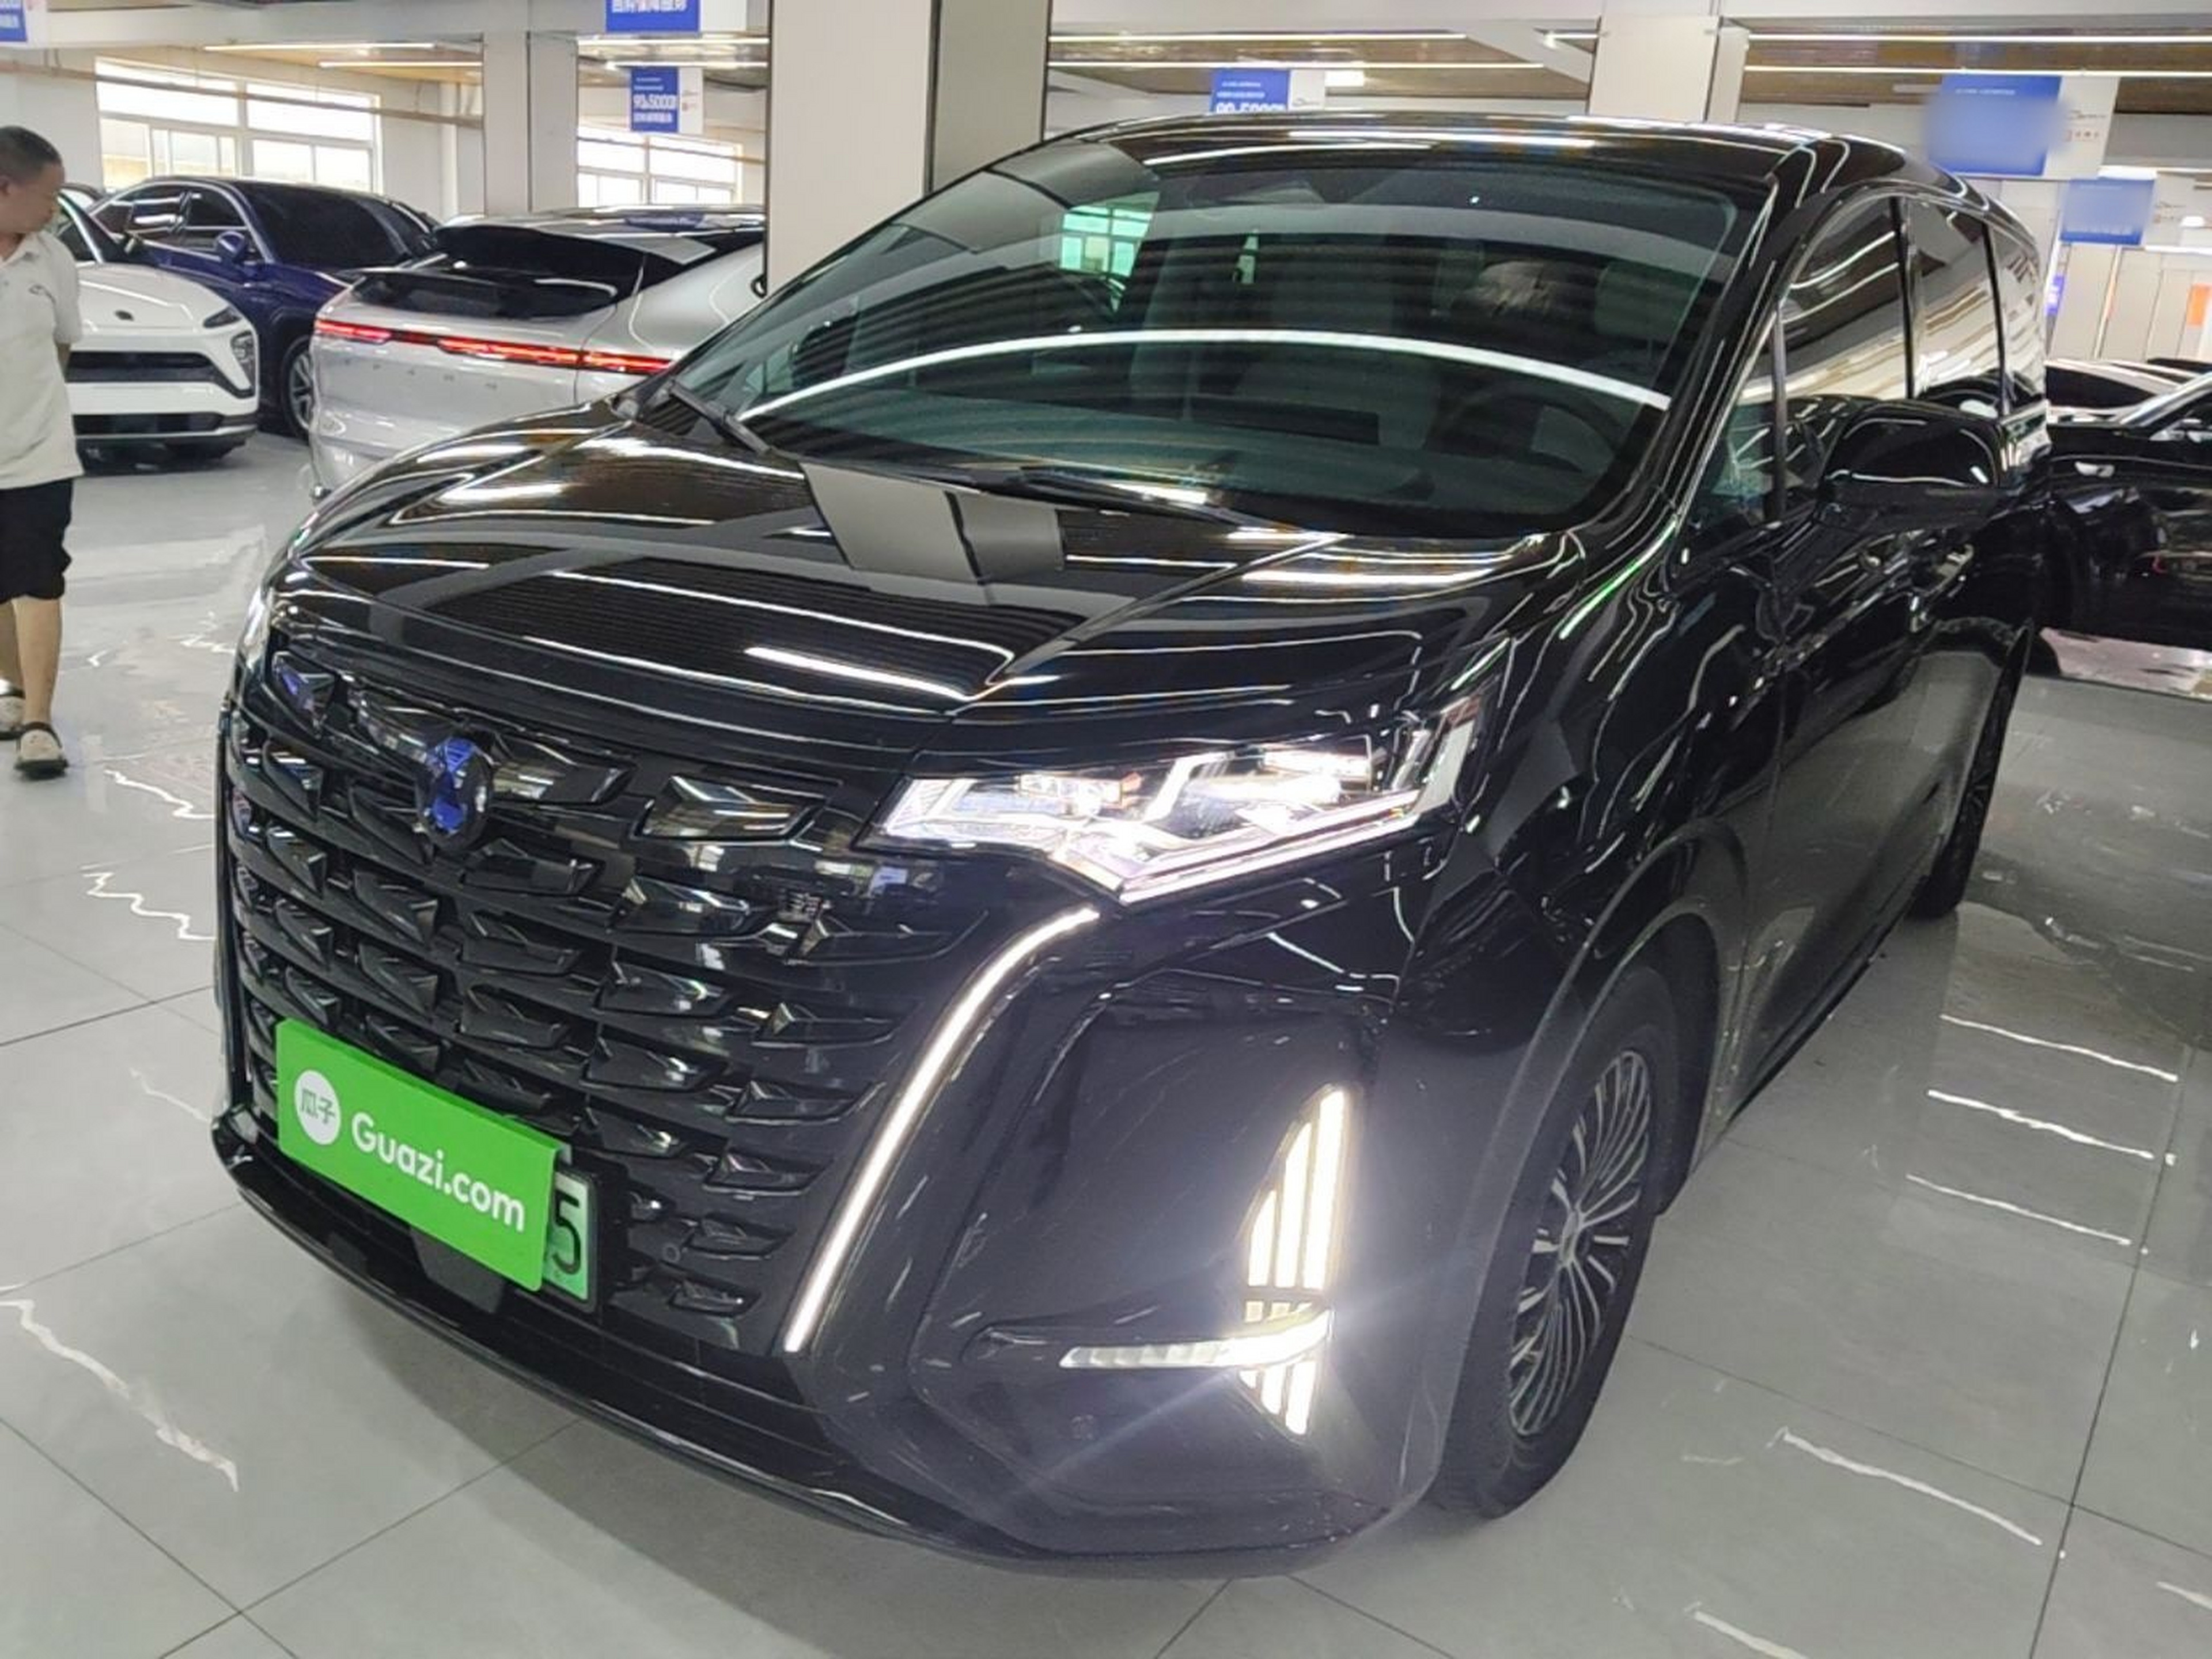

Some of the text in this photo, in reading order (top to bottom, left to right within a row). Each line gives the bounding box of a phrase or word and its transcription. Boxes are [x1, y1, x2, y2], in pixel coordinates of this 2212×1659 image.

[301, 1088, 336, 1124] 瓜子
[351, 1112, 525, 1233] Guazi.com
[552, 1191, 581, 1275] 5
